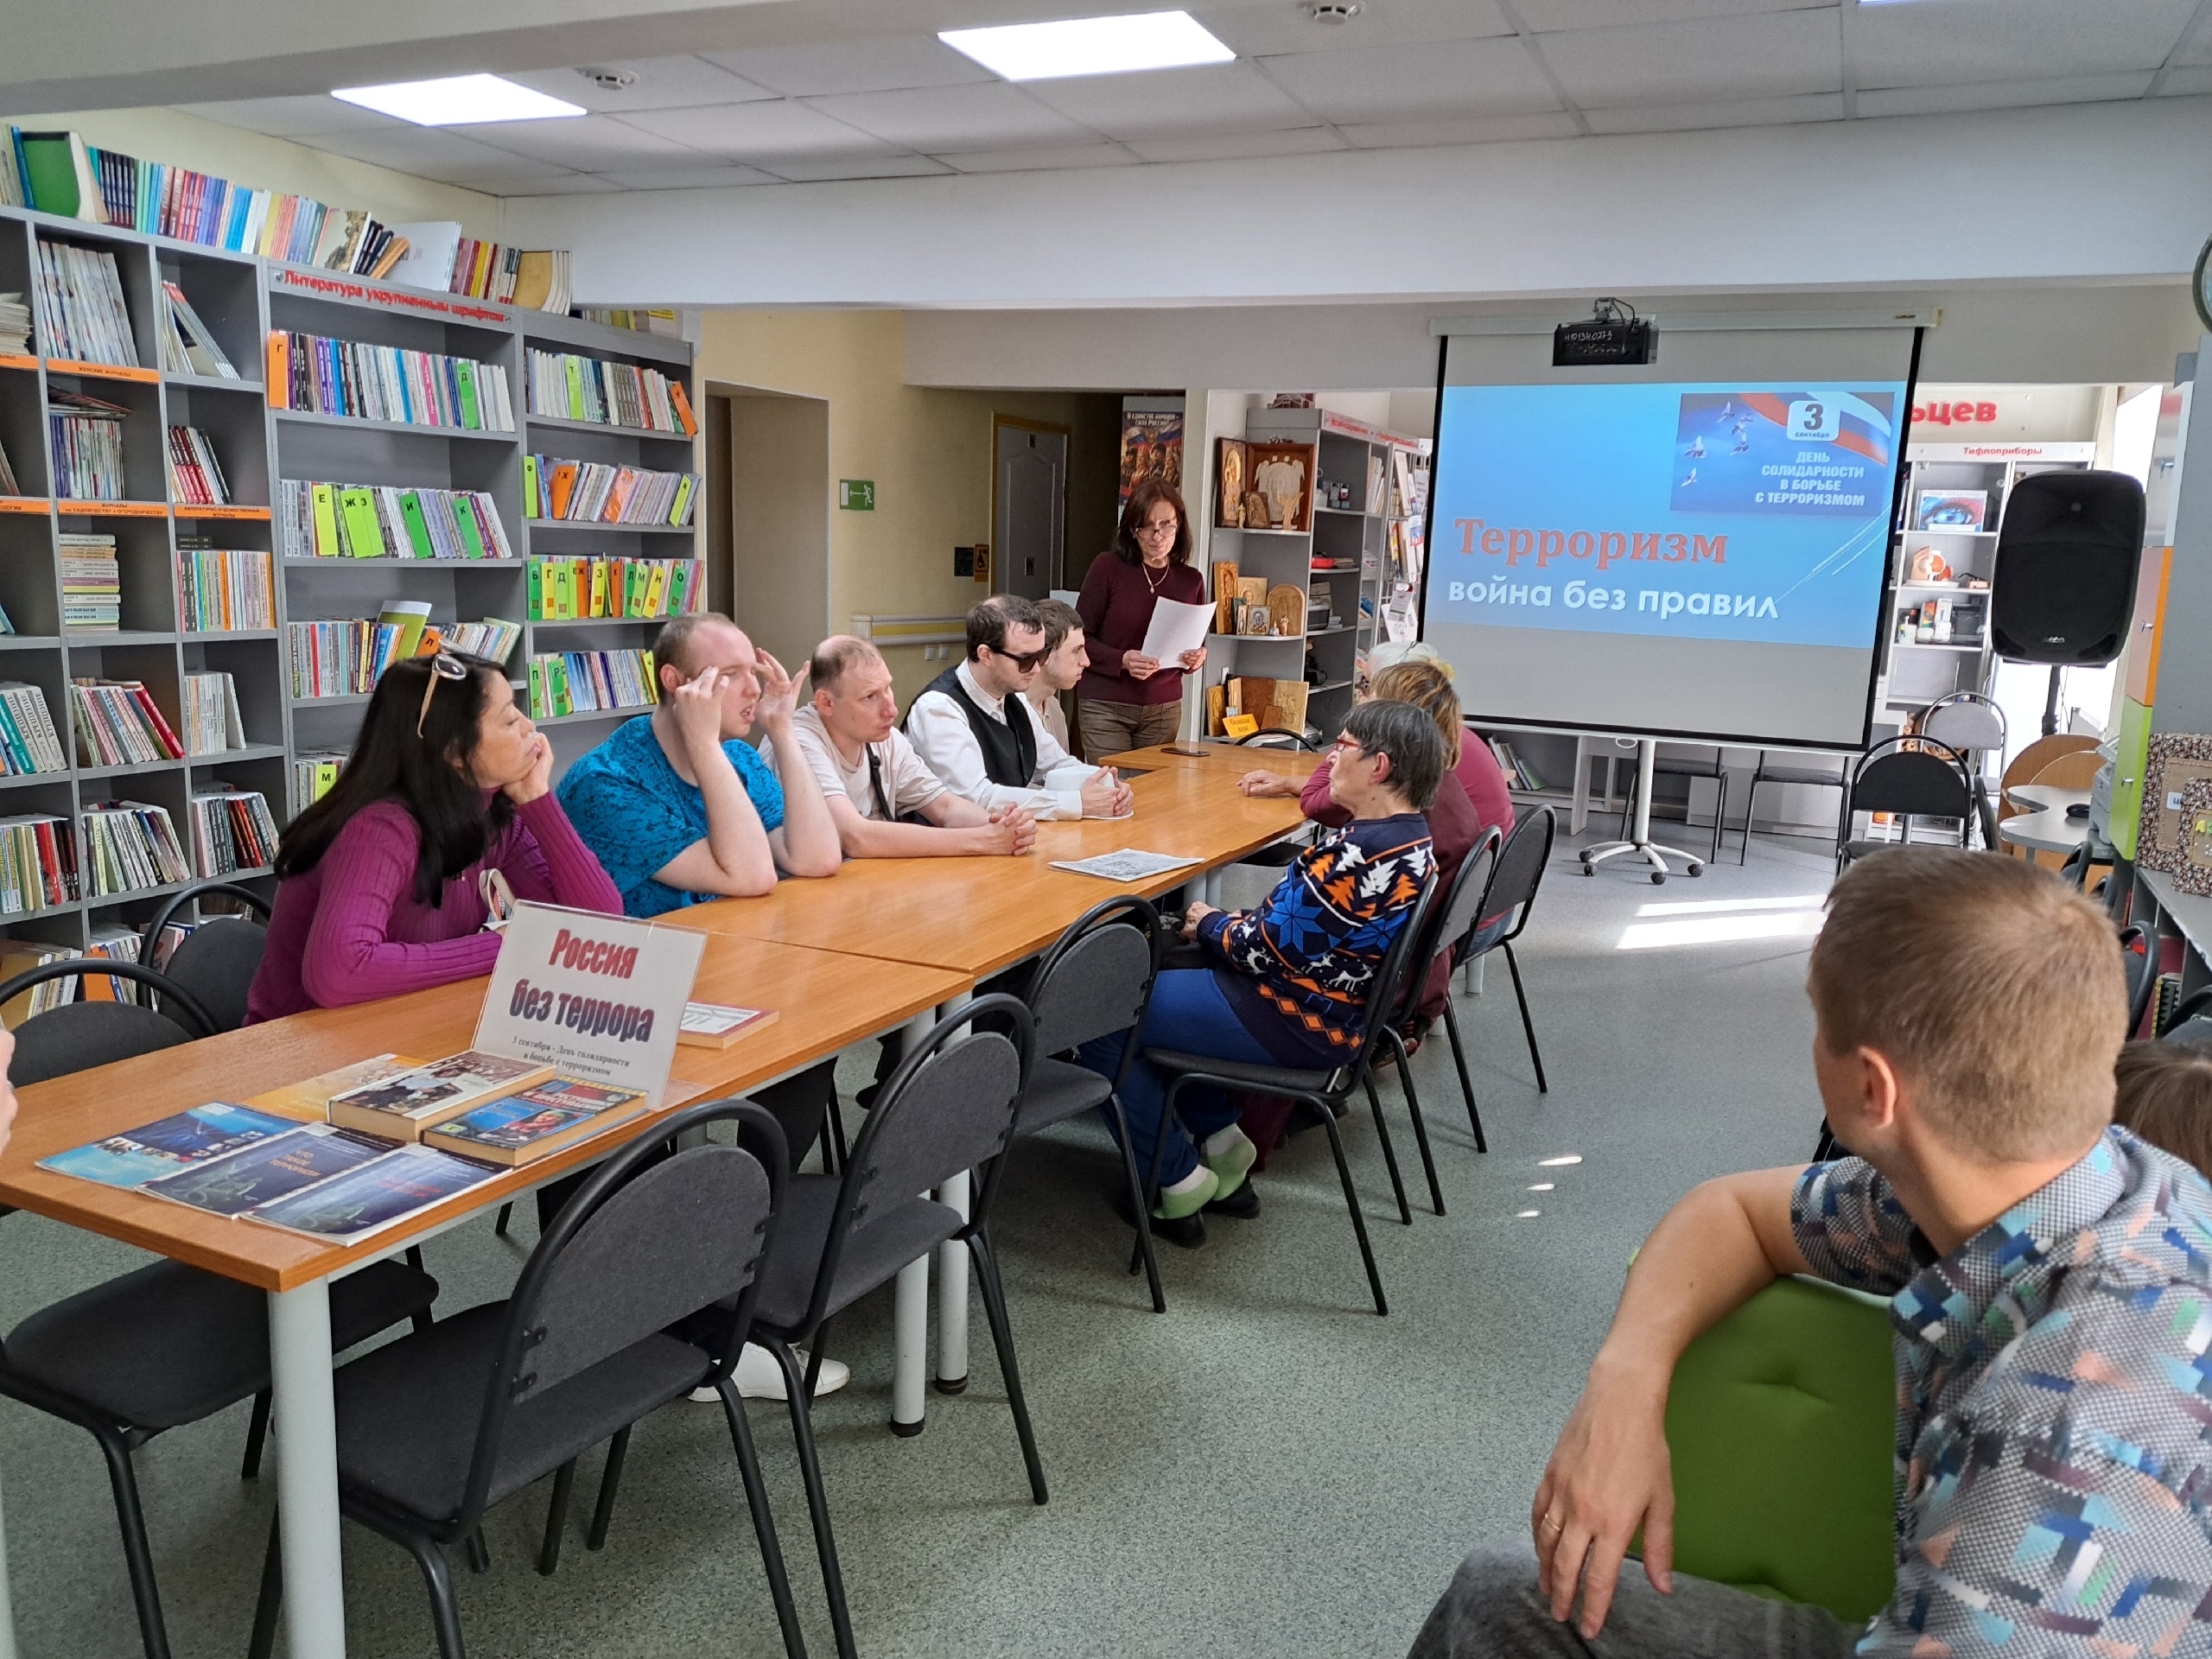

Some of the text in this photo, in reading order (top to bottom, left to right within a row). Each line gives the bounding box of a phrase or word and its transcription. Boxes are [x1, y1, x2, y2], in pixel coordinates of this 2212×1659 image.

[283, 270, 363, 297] Литература
[1803, 403, 1824, 430] 3
[1796, 451, 1831, 464] ДЕНЬ
[1963, 447, 2043, 456] Тифлоприборы
[1762, 465, 1865, 478] СОЛИДАРНОСТИ
[1780, 479, 1842, 492] В БОРЬБЕ
[318, 493, 326, 504] Е
[344, 498, 356, 508] Ж
[1755, 492, 1866, 506] С ТЕРРОРИЗМОМ
[406, 502, 414, 512] И
[460, 505, 467, 515] К
[1454, 518, 1729, 570] Терроризм
[557, 572, 566, 583] Д
[638, 571, 645, 582] М
[655, 574, 662, 583] Н
[1448, 574, 1552, 607] война
[1563, 580, 1626, 611] без
[1637, 589, 1780, 620] правил
[532, 670, 538, 680] П
[554, 667, 560, 677] Р
[5, 694, 31, 740] КРЕЩЕНИЕ
[19, 694, 43, 738] КРЕЩЕНИЕ
[34, 691, 54, 737] КРЕЩЕНИЕ
[321, 772, 331, 782] М
[548, 929, 639, 979] Россия
[509, 978, 655, 1042] без террора
[518, 1038, 551, 1052] сентября
[556, 1045, 575, 1056] День
[577, 1051, 630, 1067] солидарности
[529, 1052, 554, 1065] борьбе
[562, 1059, 611, 1077] терроризмом
